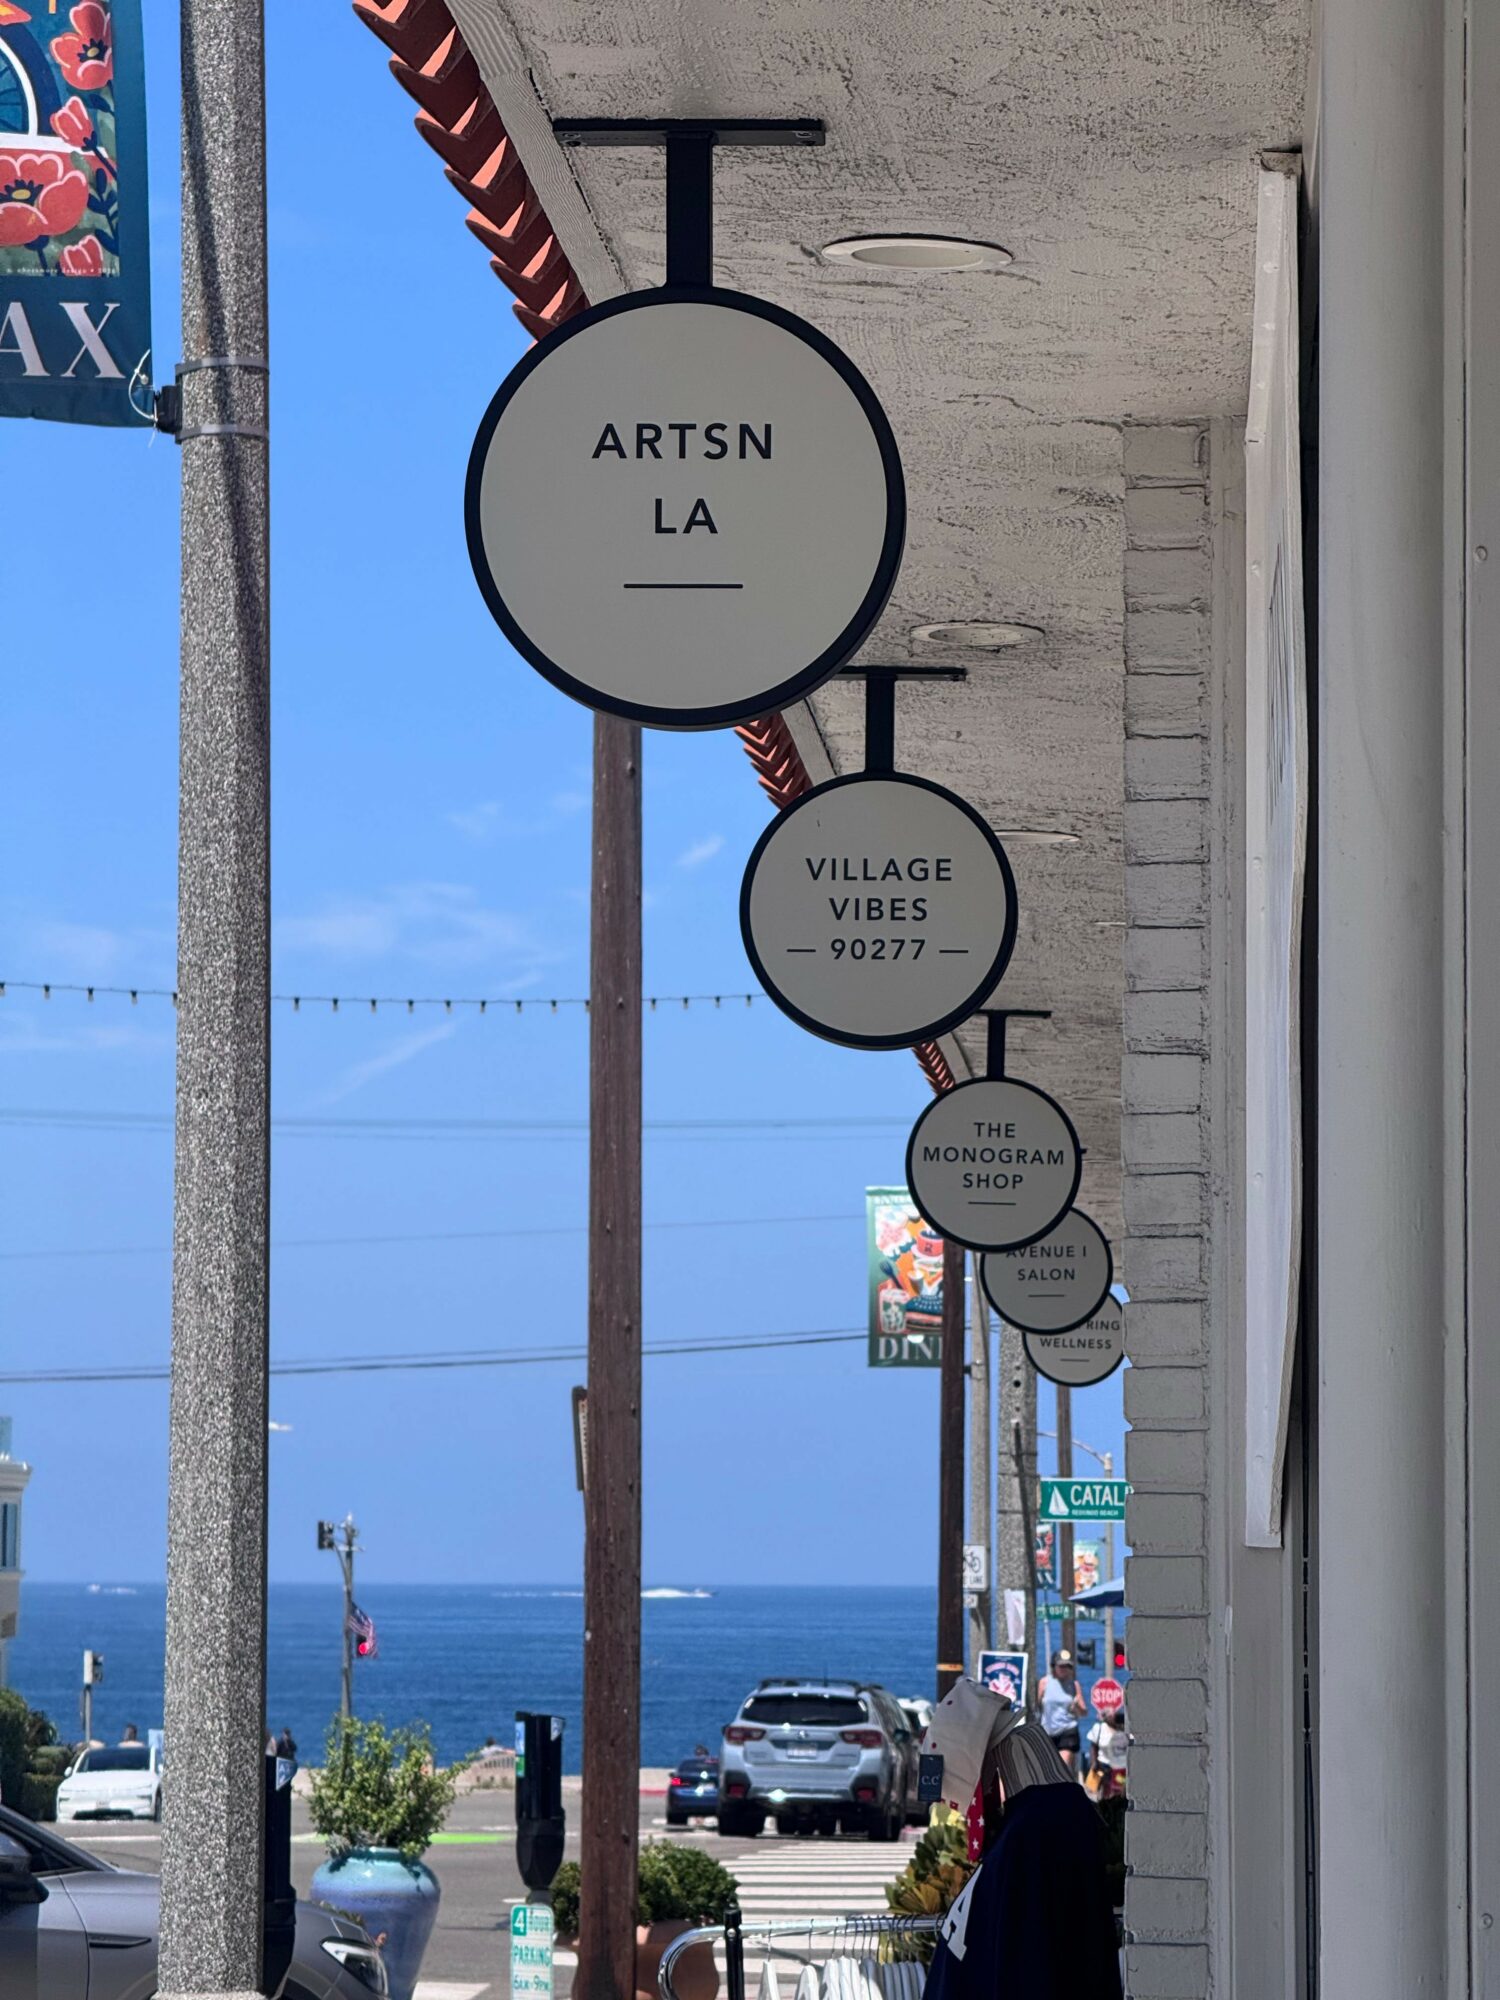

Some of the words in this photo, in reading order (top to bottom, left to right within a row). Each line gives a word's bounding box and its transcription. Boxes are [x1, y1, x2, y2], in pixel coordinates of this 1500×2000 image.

[591, 422, 772, 460] ARTSN
[654, 498, 719, 534] LA
[805, 857, 952, 882] VILLAGE
[828, 897, 928, 922] VIBES
[830, 938, 926, 961] 90277
[973, 1122, 1016, 1138] THE
[923, 1146, 1064, 1165] MONOGRAM
[962, 1172, 1024, 1189] SHOP
[1082, 1246, 1087, 1258] I
[1017, 1268, 1075, 1281] SALON
[1085, 1320, 1120, 1331] RING
[878, 1336, 943, 1360] DIN
[1039, 1337, 1112, 1350] WELLNESS
[1092, 1687, 1121, 1703] STOP
[513, 1910, 525, 1933] 4
[513, 1944, 551, 1966] PARKING
